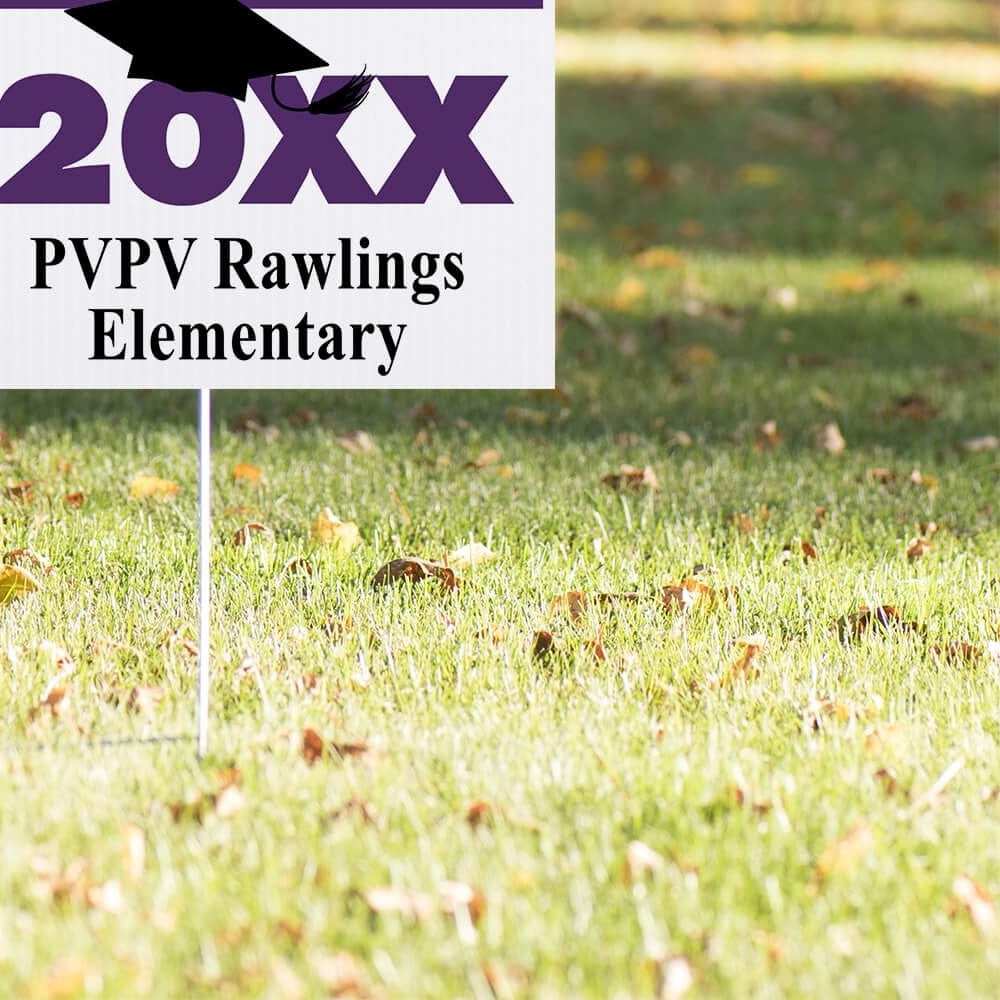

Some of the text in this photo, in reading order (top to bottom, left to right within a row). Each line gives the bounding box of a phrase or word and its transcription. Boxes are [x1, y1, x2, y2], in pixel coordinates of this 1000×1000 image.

[30, 237, 465, 306] PVPV Rawlings
[88, 308, 408, 377] Elementary
